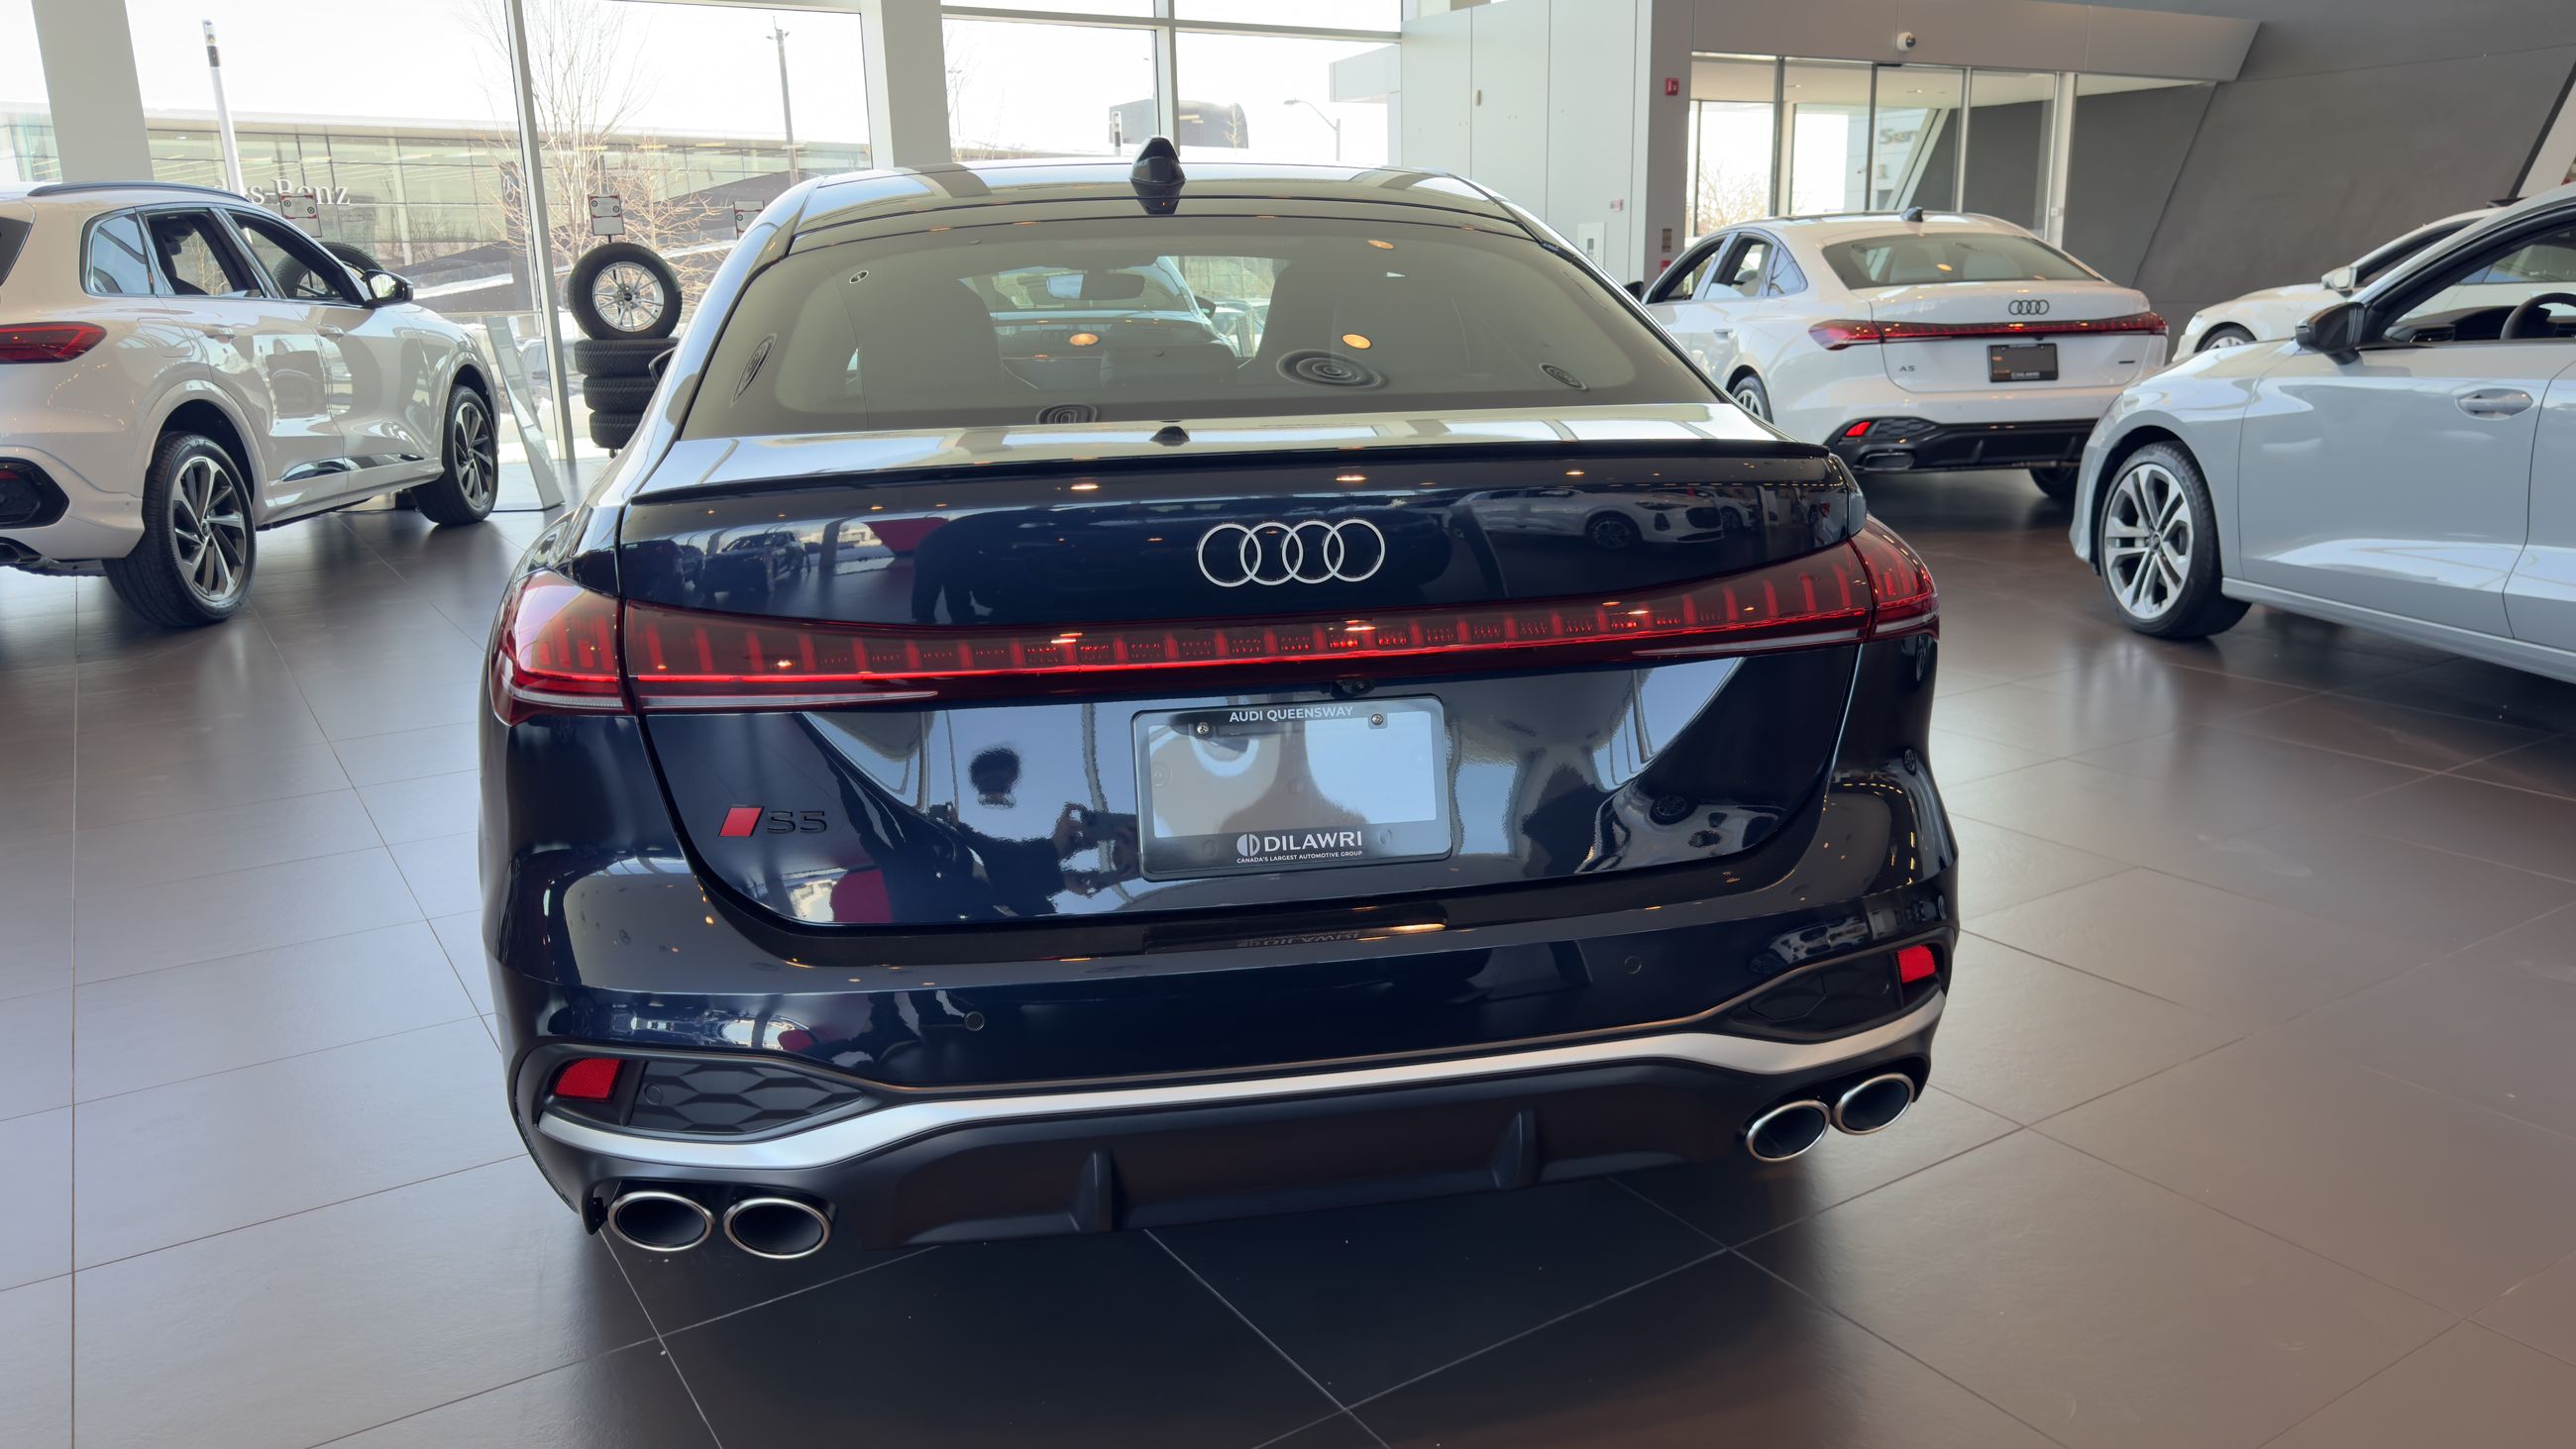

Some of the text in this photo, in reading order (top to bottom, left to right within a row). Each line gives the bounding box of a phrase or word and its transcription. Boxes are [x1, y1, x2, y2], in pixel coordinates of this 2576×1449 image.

[1230, 705, 1353, 723] AUDI QUEENSWAY
[767, 810, 827, 835] S5
[1263, 830, 1362, 852] DILAWRI
